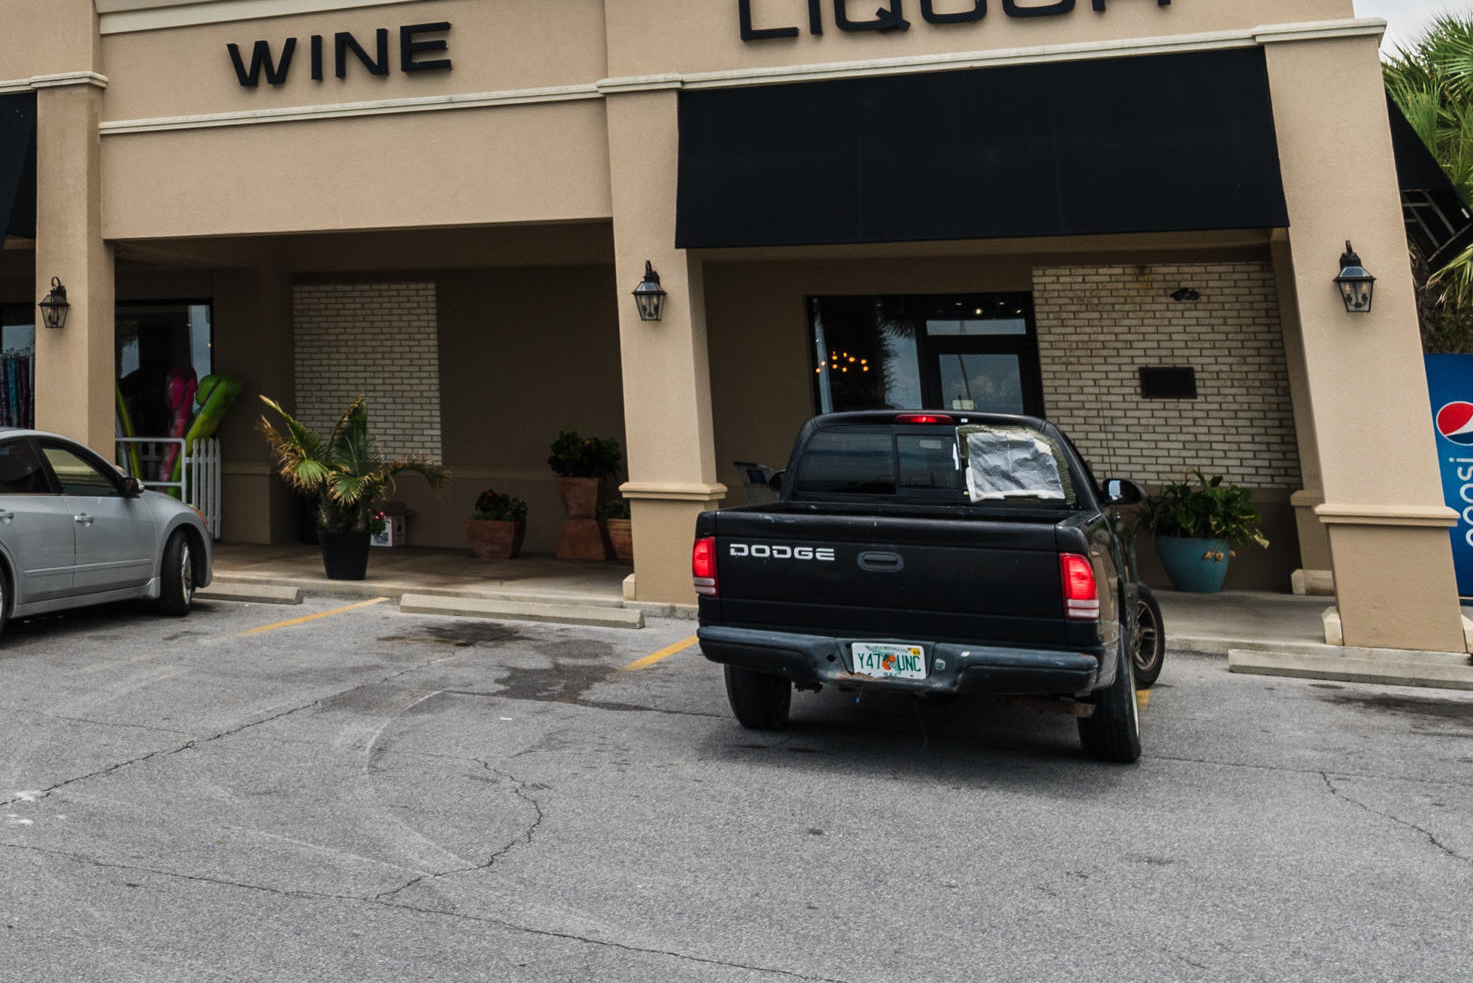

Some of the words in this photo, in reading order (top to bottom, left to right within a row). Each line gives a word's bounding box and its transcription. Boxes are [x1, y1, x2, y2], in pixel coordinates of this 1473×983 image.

[226, 21, 454, 88] WINE
[729, 543, 836, 561] DODGE
[857, 653, 881, 669] Y47
[897, 654, 921, 672] UNC
